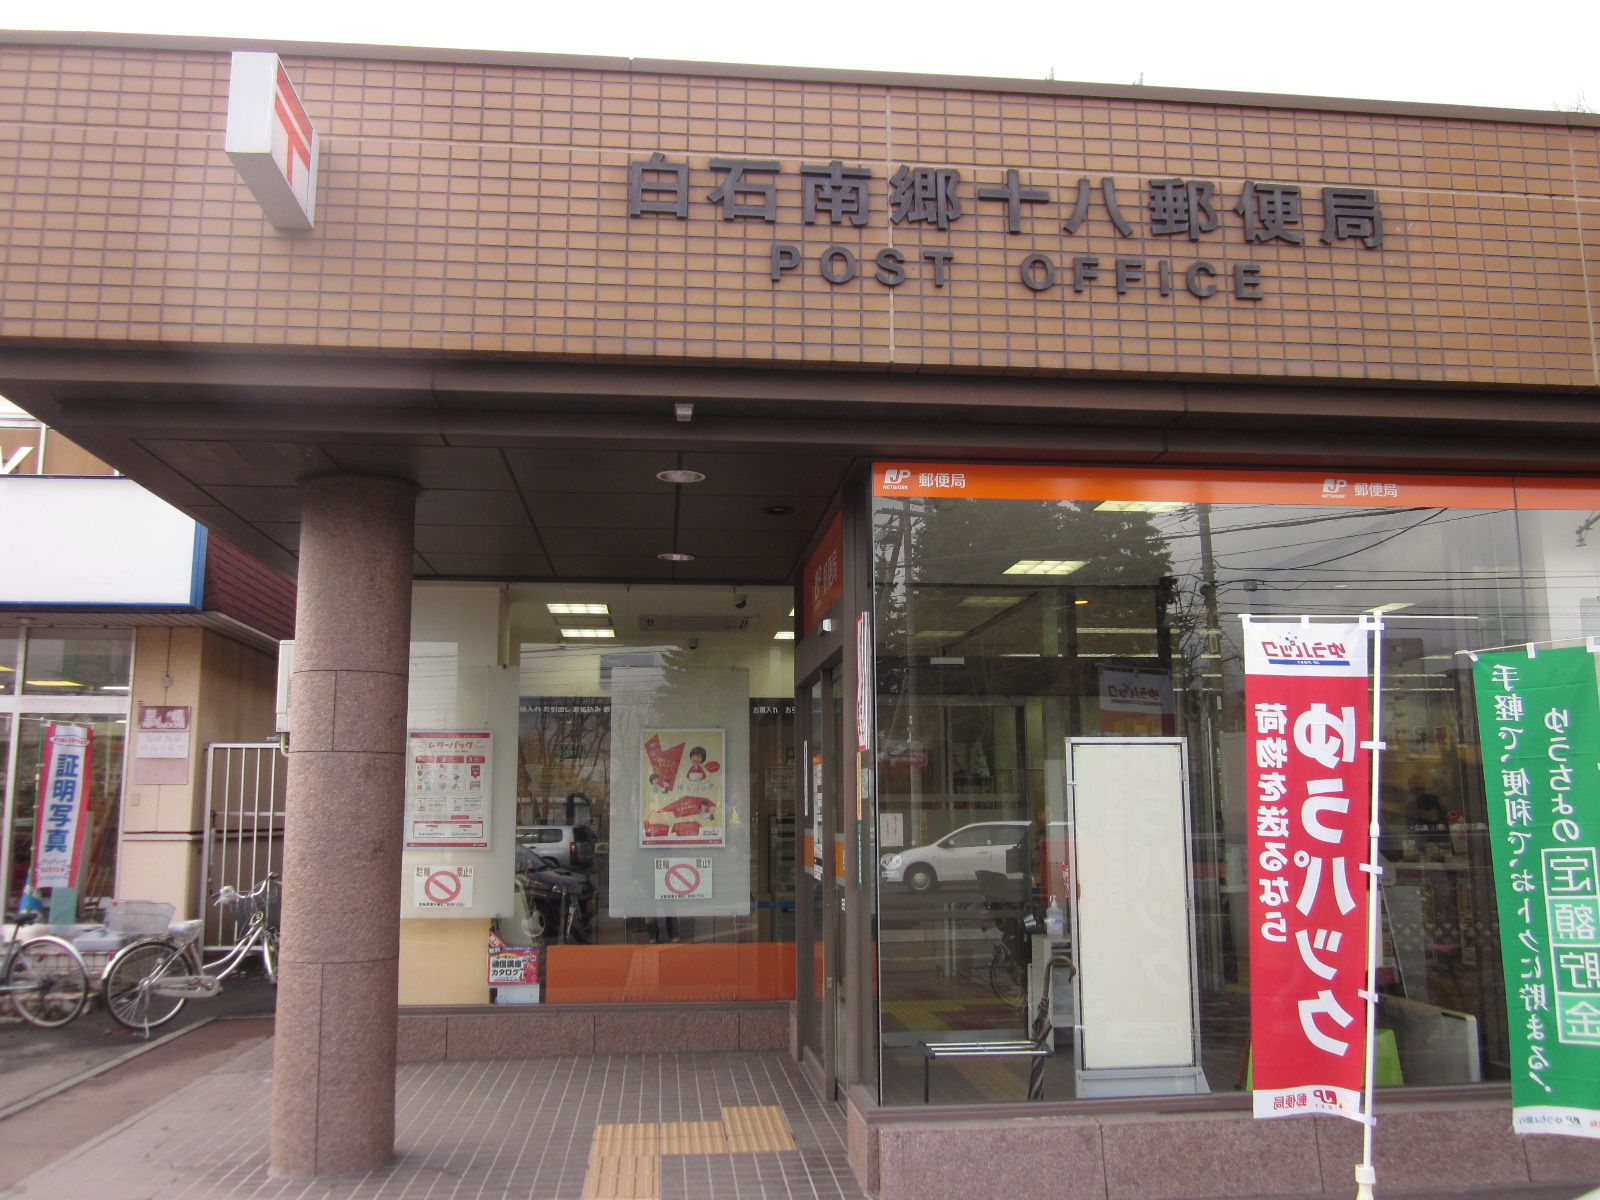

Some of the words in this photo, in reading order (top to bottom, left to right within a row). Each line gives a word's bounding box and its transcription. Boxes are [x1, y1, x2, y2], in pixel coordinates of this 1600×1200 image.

[628, 152, 1383, 249] 白石南郷十八郵便局
[771, 244, 953, 288] POST
[1020, 253, 1264, 300] OFFICE
[919, 473, 966, 488] 郵便局
[1354, 483, 1397, 497] 郵便局
[428, 740, 473, 749] レターパック
[46, 754, 80, 853] 証明写真
[492, 969, 519, 977] カタログ
